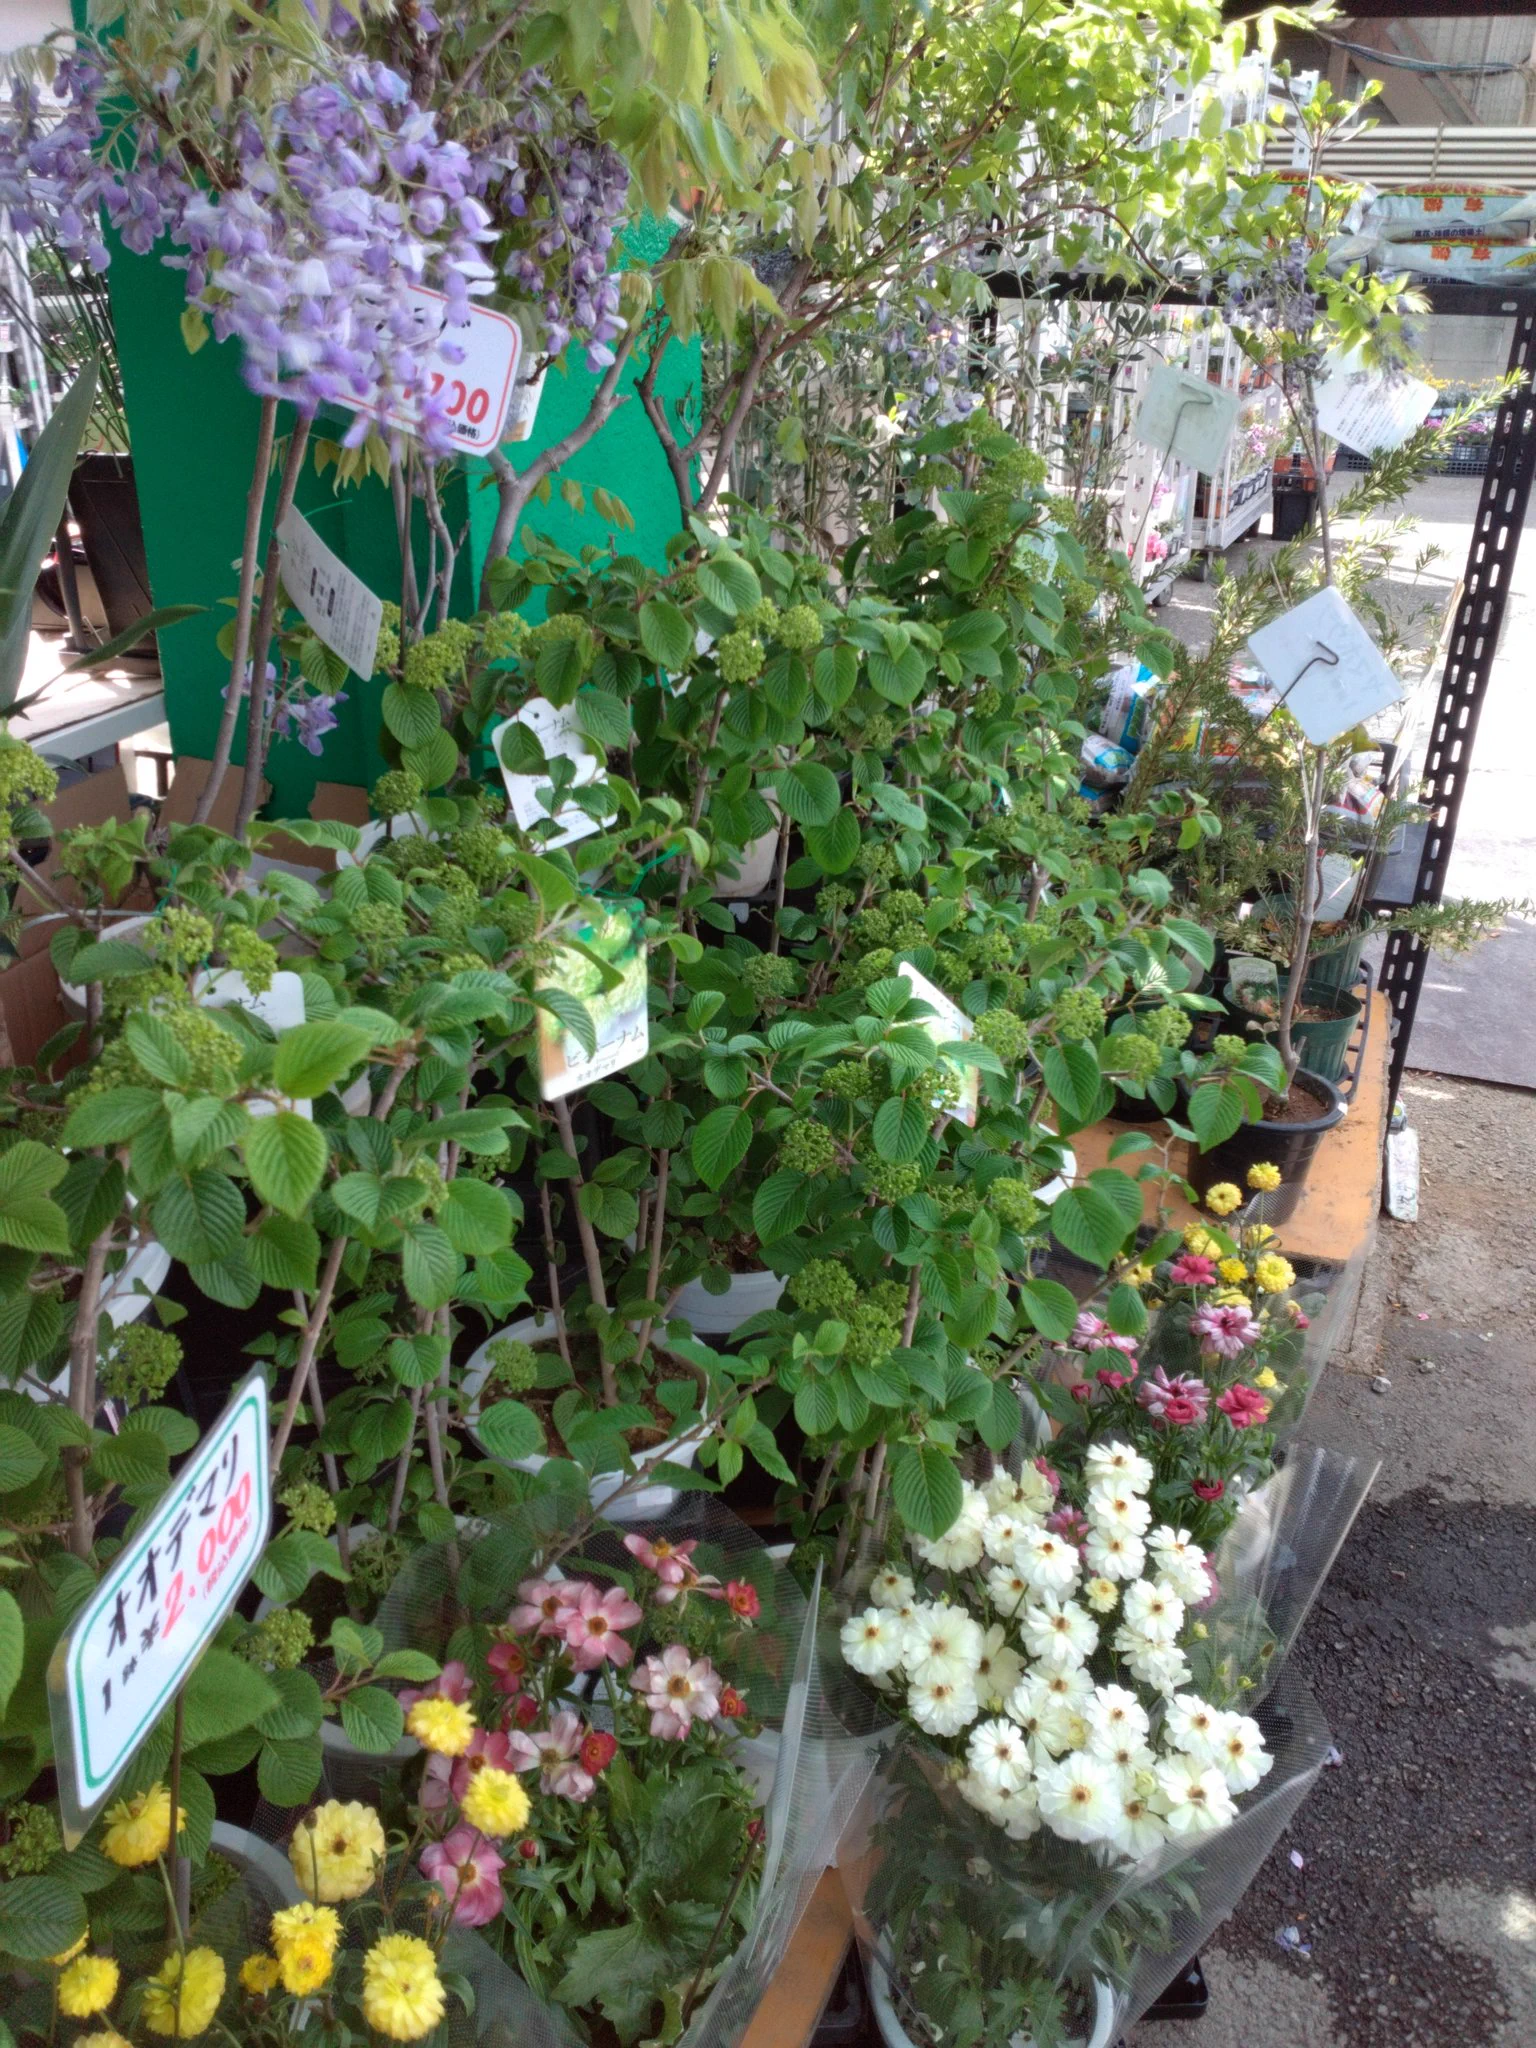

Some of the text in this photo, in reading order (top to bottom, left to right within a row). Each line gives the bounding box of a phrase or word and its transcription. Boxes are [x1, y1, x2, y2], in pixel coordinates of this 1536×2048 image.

[106, 1433, 238, 1658] オオデマリ
